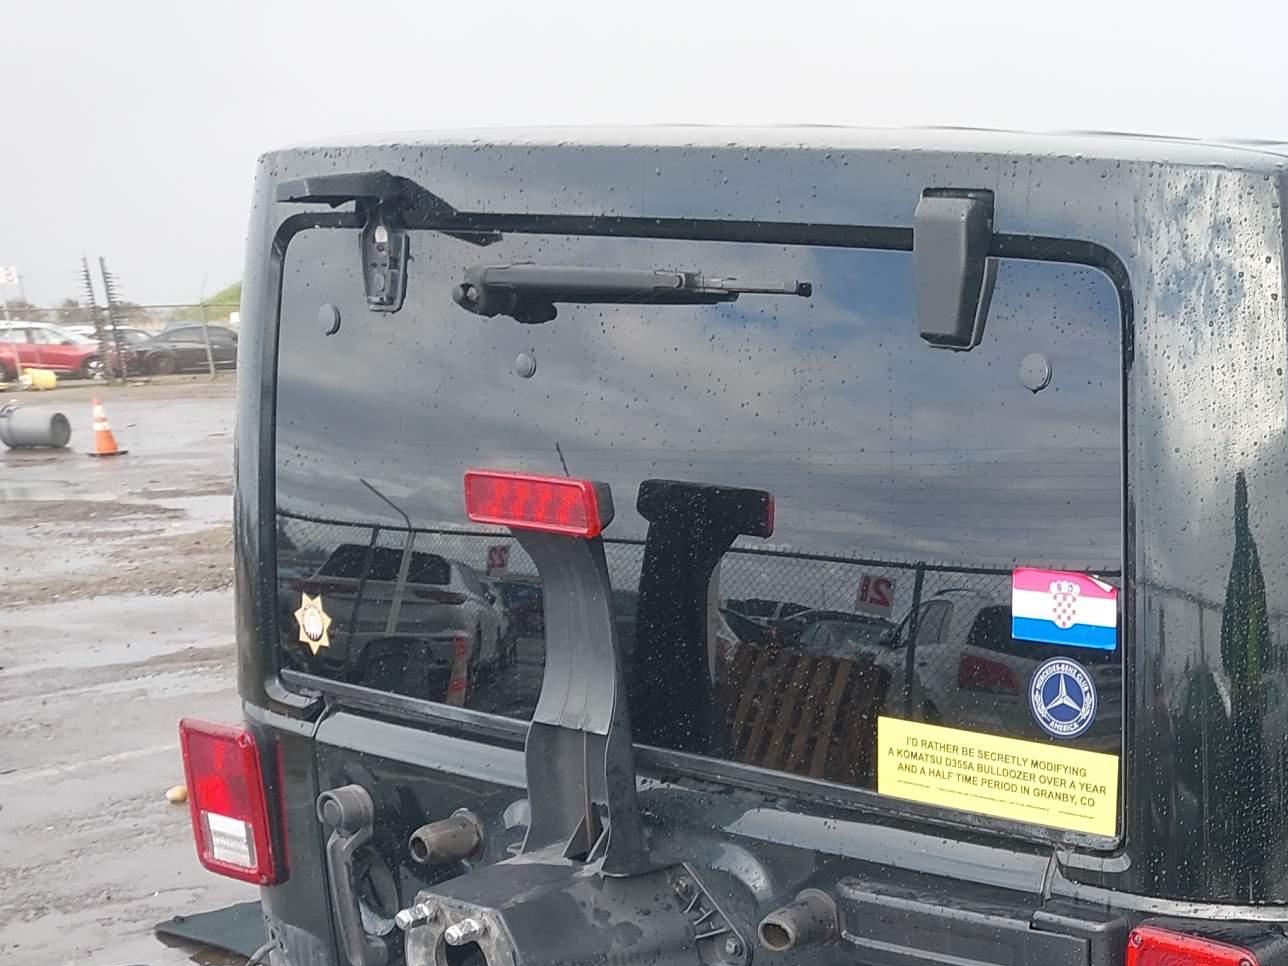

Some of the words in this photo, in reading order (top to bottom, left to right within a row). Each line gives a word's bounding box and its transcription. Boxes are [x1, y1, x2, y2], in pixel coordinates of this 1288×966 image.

[1049, 720, 1079, 732] AMERICA
[888, 747, 894, 756] A
[896, 748, 942, 765] KOMATSU
[945, 757, 974, 771] D355A
[977, 763, 1036, 783] BULLDOZER
[1039, 774, 1066, 788] OVER
[1069, 780, 1076, 790] A
[1079, 781, 1106, 795] YEAR
[906, 736, 918, 747] I'D
[921, 739, 959, 754] RATHER
[961, 746, 975, 757] BE
[977, 749, 1029, 766] SECRETLY
[1031, 759, 1087, 778] MODIFYING
[897, 762, 917, 774] AND
[919, 767, 926, 776] A
[929, 768, 953, 780] HALF
[956, 773, 978, 786] TIME
[981, 778, 1017, 793] PERIOD
[1020, 785, 1030, 796] IN
[1033, 787, 1077, 806] GRANBY,
[1080, 796, 1095, 807] CO
